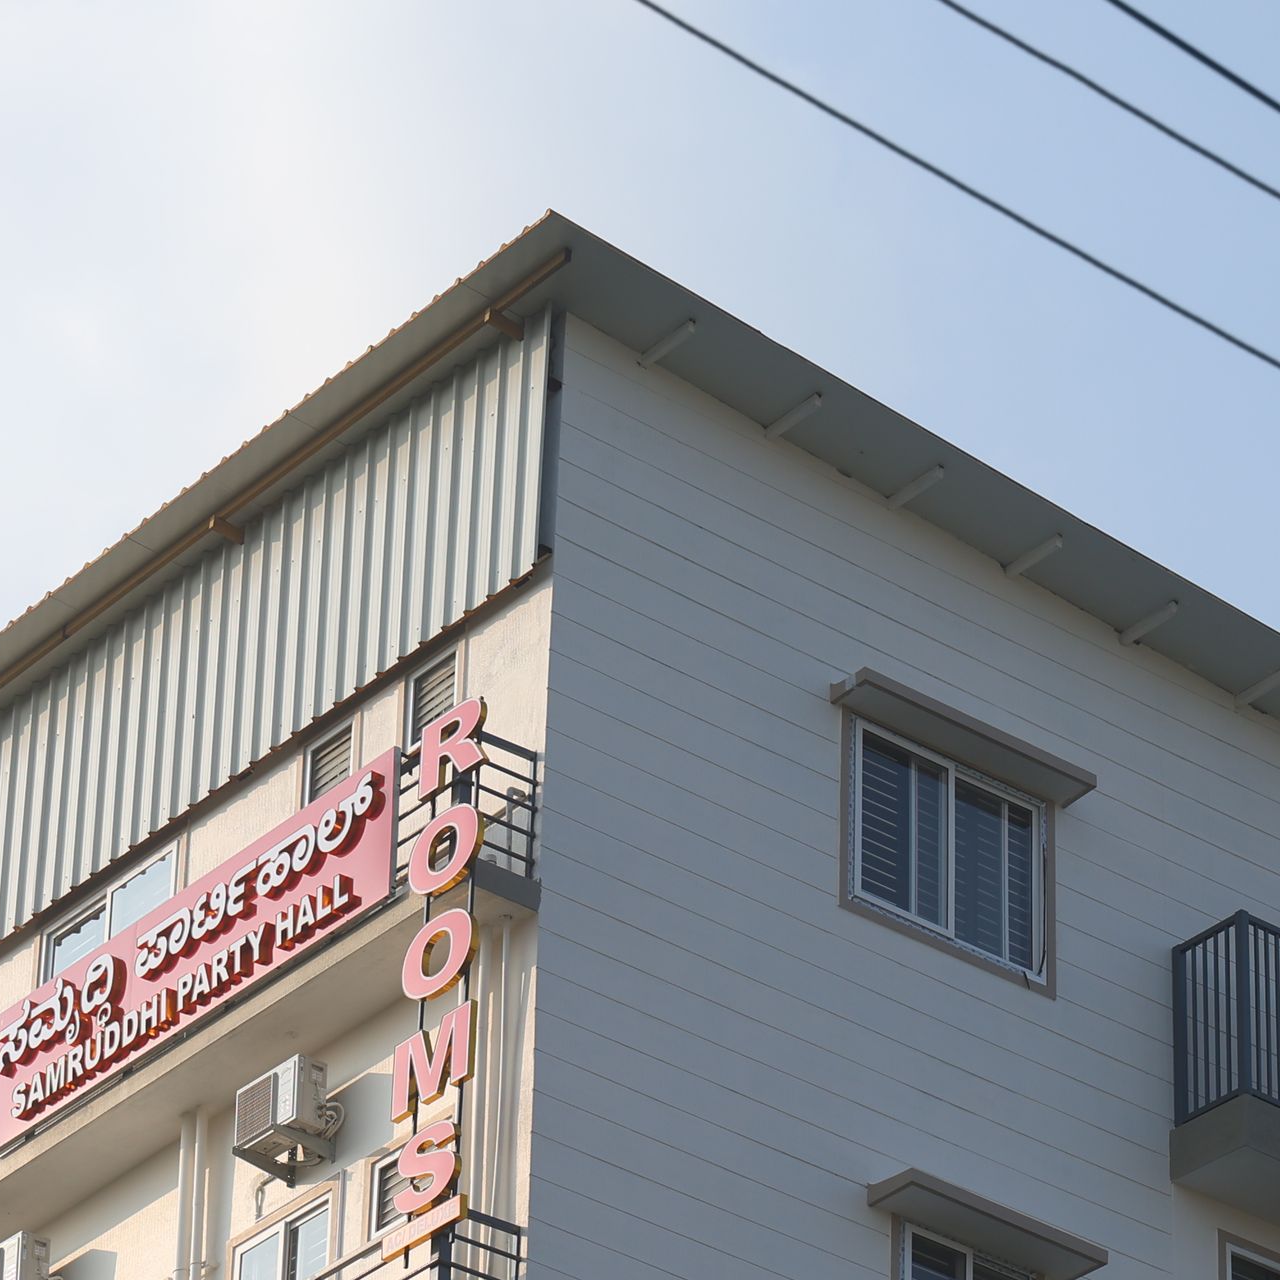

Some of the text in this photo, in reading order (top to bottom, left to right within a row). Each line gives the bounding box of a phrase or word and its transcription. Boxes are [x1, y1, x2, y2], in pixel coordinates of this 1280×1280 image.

[11, 873, 350, 1118] SAMRUDDHI PARTY HALL
[391, 698, 484, 1214] ROOMS
